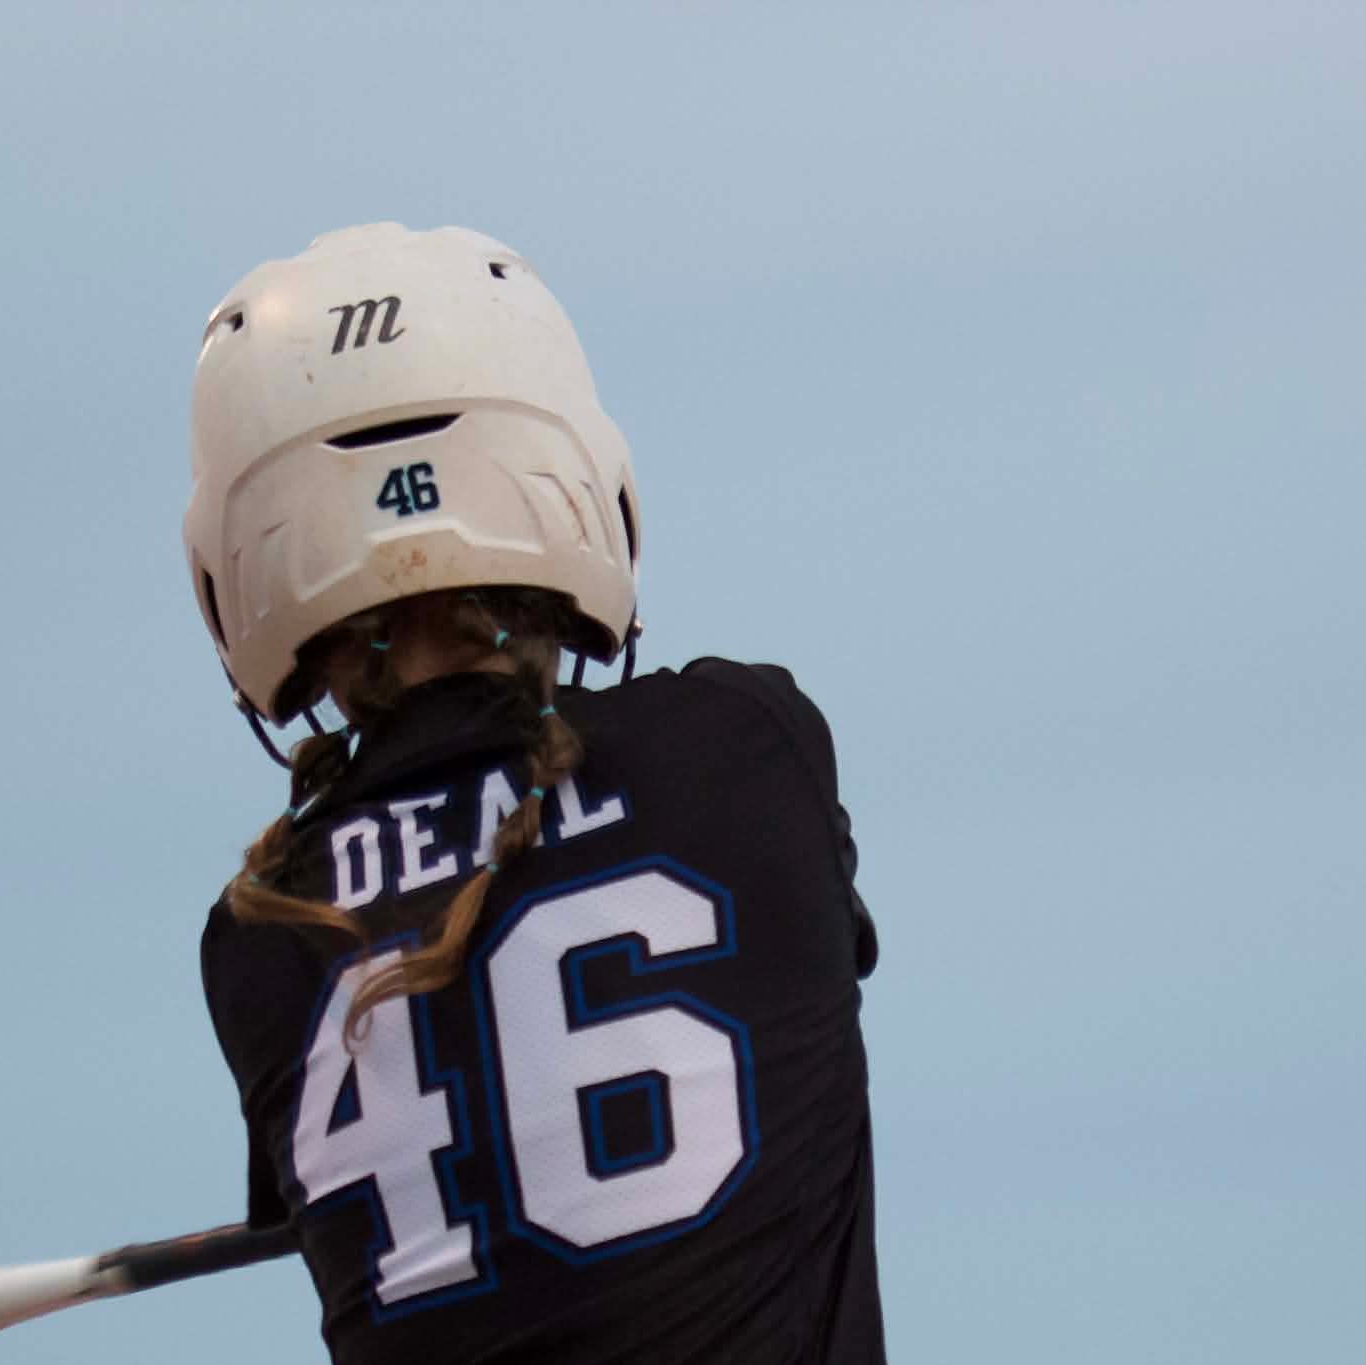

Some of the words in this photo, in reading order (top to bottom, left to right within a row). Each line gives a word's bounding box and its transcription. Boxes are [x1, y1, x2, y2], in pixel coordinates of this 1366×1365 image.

[328, 294, 407, 356] m
[375, 461, 441, 518] 46
[328, 766, 627, 913] DEAL
[291, 862, 750, 1313] 46
